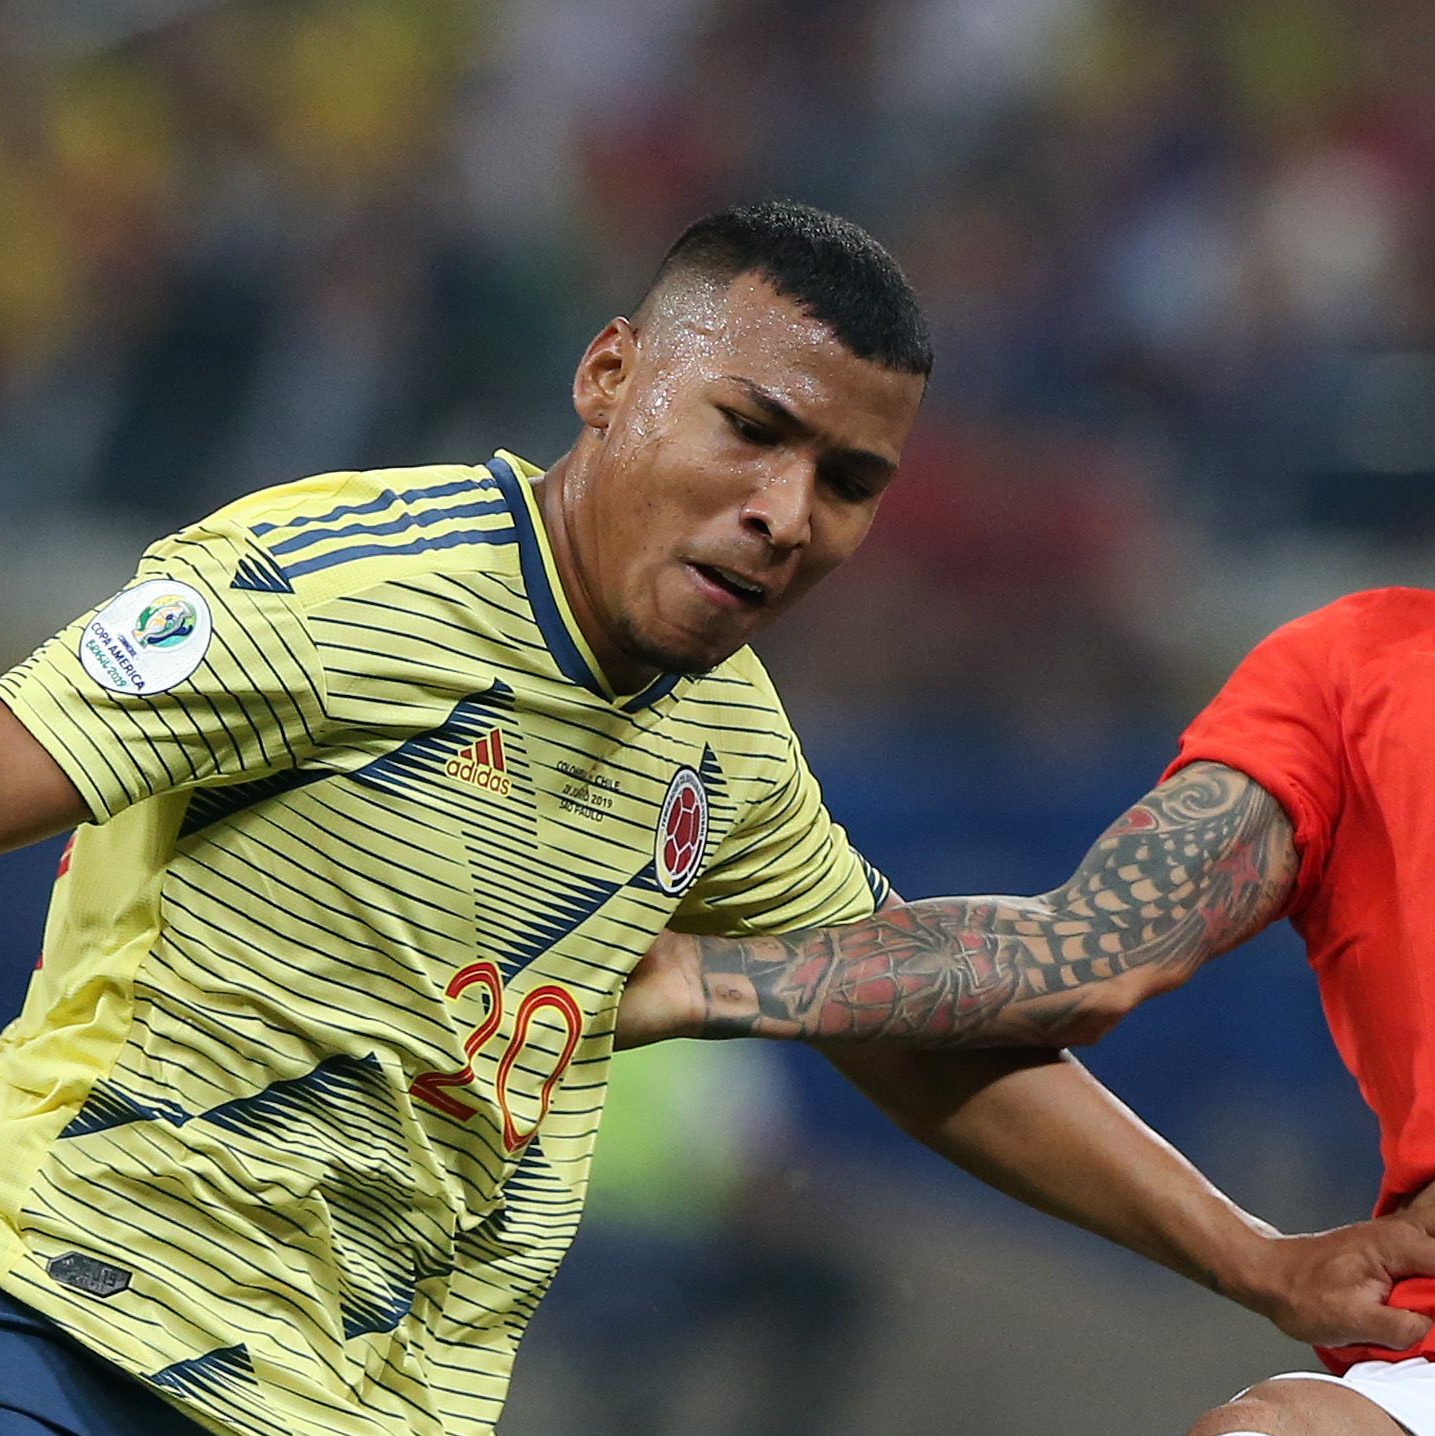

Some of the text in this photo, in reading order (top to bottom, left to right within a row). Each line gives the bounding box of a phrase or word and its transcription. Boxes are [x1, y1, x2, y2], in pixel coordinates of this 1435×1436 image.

[91, 622, 112, 648] COPA
[108, 644, 145, 691] AMERICA
[108, 668, 128, 688] 2019
[446, 760, 511, 796] adidas
[595, 775, 621, 792] CHILE
[591, 794, 614, 809] 2019
[409, 962, 583, 1154] 20
